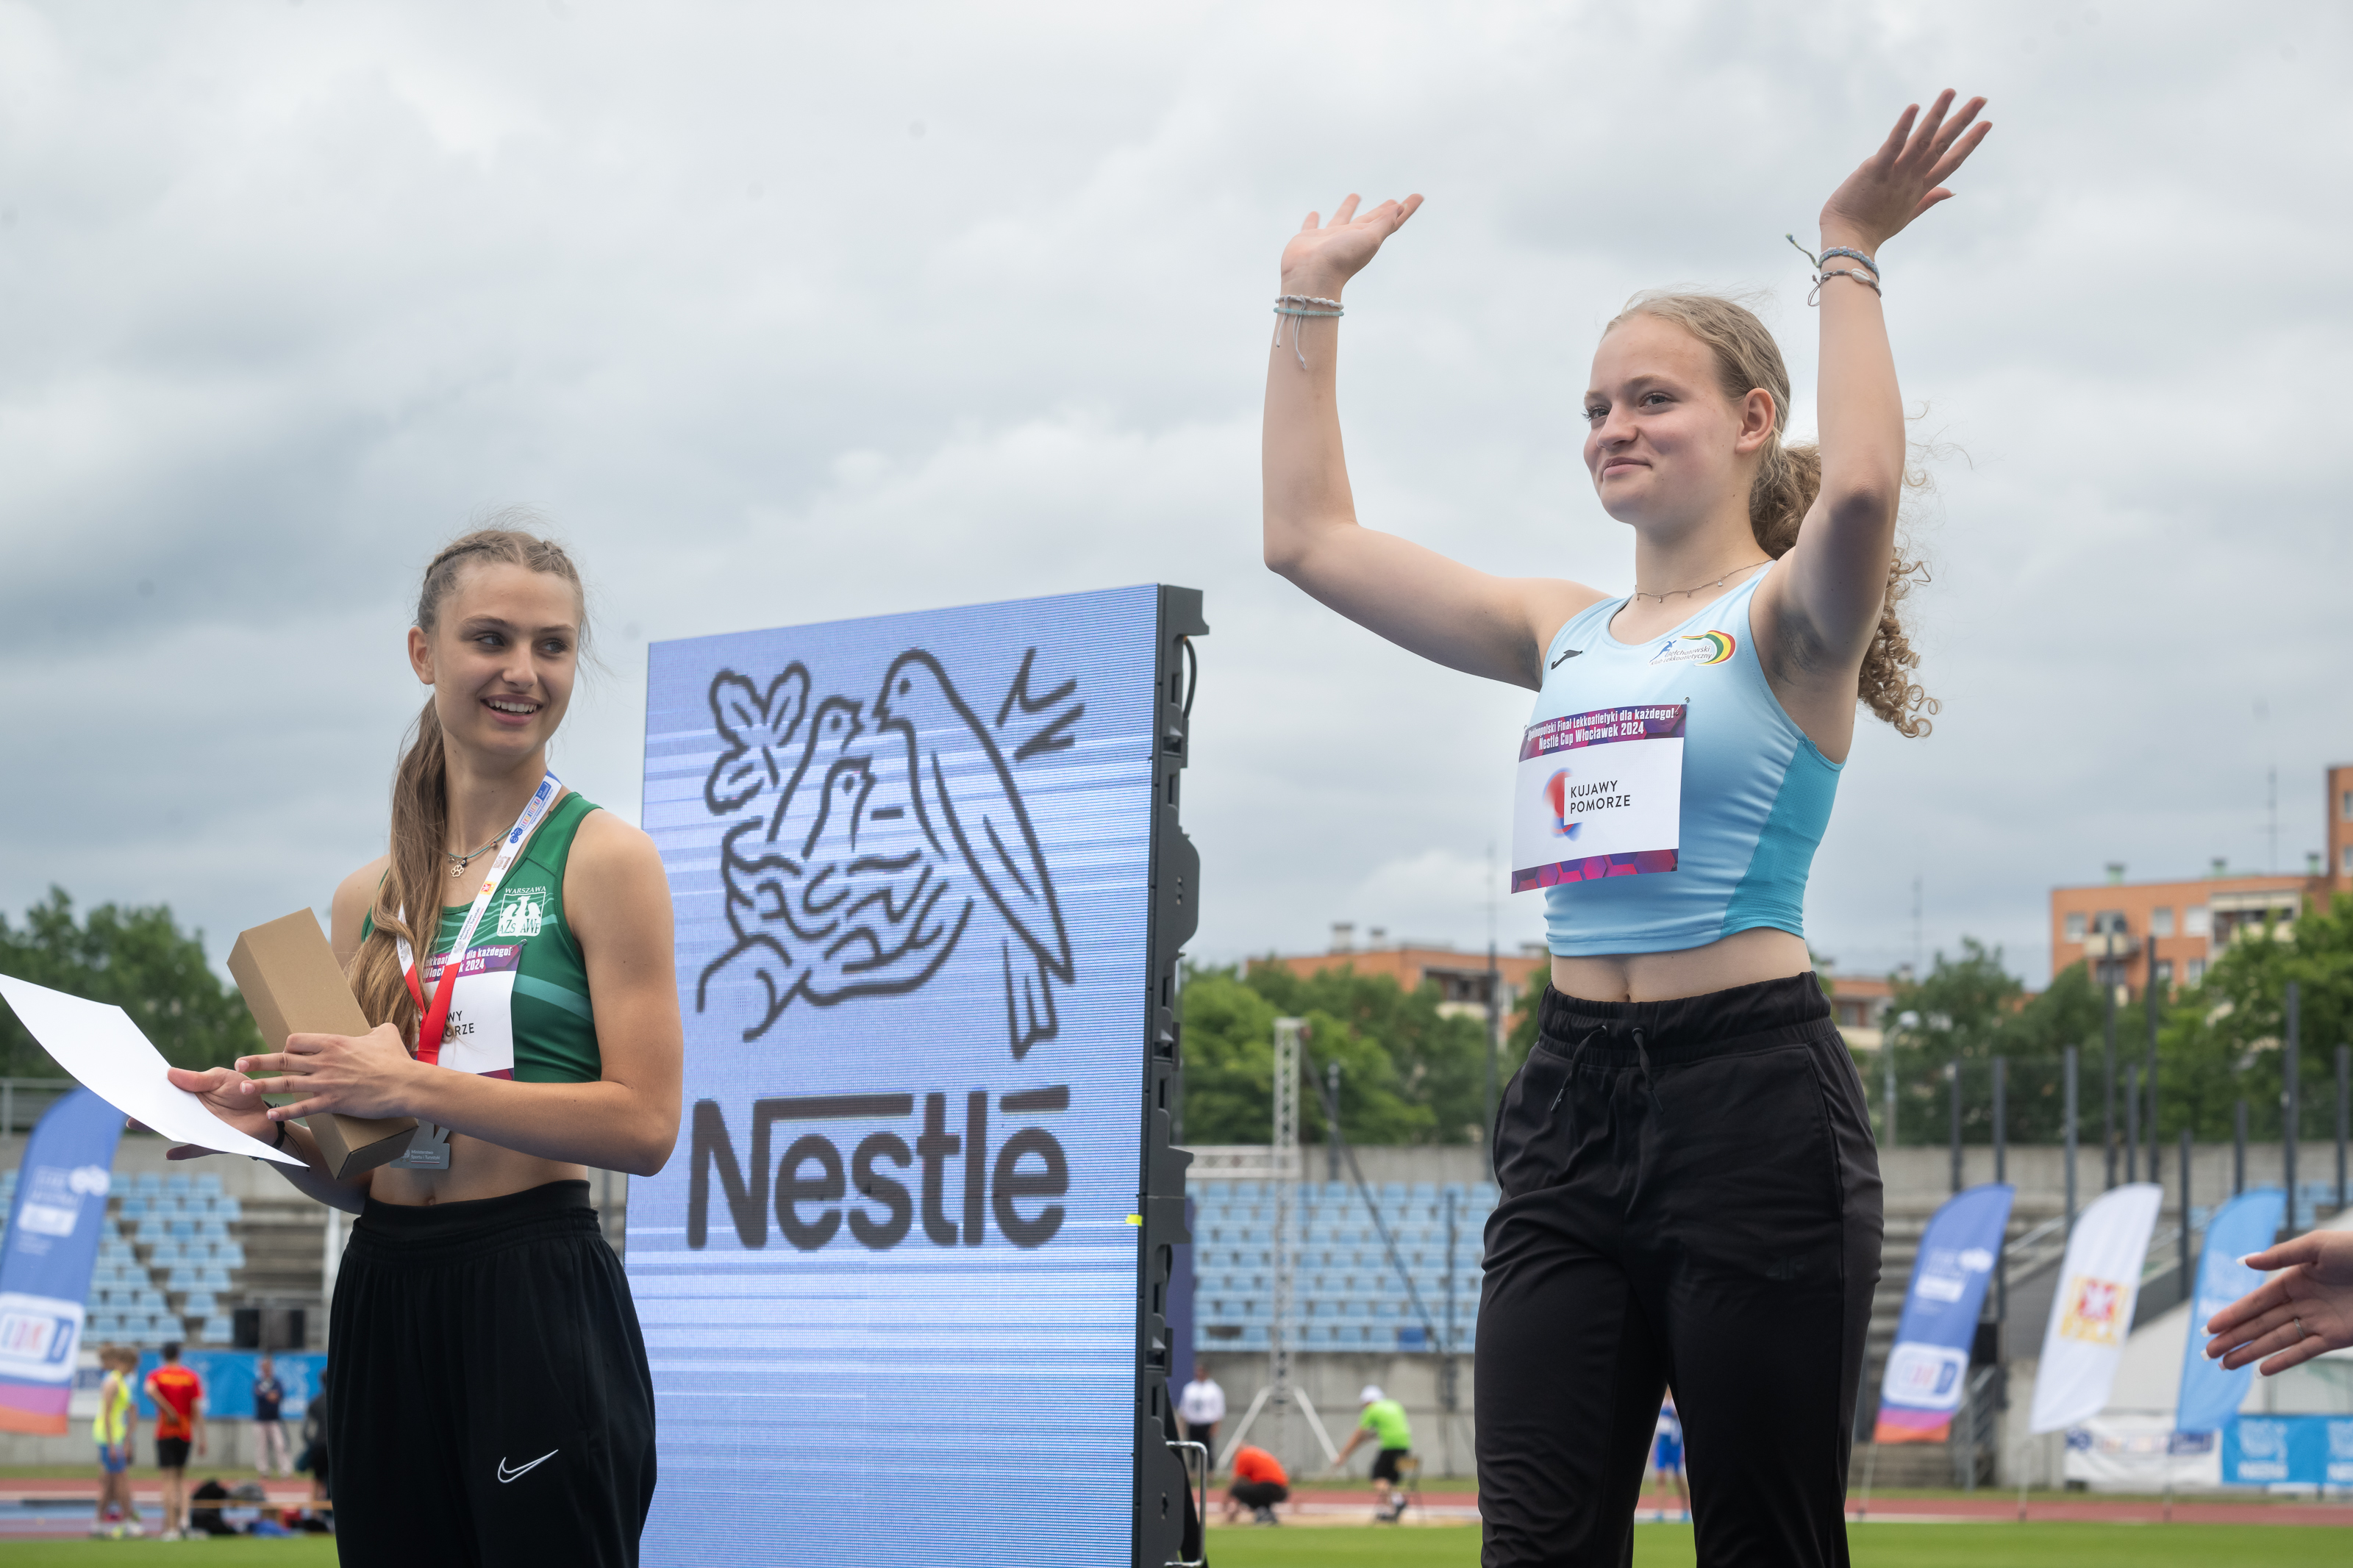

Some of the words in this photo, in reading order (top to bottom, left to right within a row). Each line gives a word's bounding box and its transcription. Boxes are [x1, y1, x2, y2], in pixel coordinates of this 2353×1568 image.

[1557, 718, 1571, 731] Finał
[1574, 711, 1618, 728] Lekkoatletyki
[1620, 709, 1632, 721] dla
[1635, 707, 1674, 720] każdego!
[1539, 734, 1559, 751] Nestlé
[1560, 732, 1574, 745] Cup
[1575, 723, 1618, 742] Włocławek
[1621, 721, 1644, 736] 2024
[1571, 780, 1618, 798] KUJAWY
[1570, 795, 1630, 814] POMORZE
[505, 886, 546, 894] WARSZAWA
[498, 919, 516, 934] AZS
[520, 918, 540, 934] AWF
[466, 950, 476, 960] dla
[477, 947, 512, 957] każdego!
[465, 958, 485, 972] 2024
[688, 1084, 1070, 1252] Nestlé
